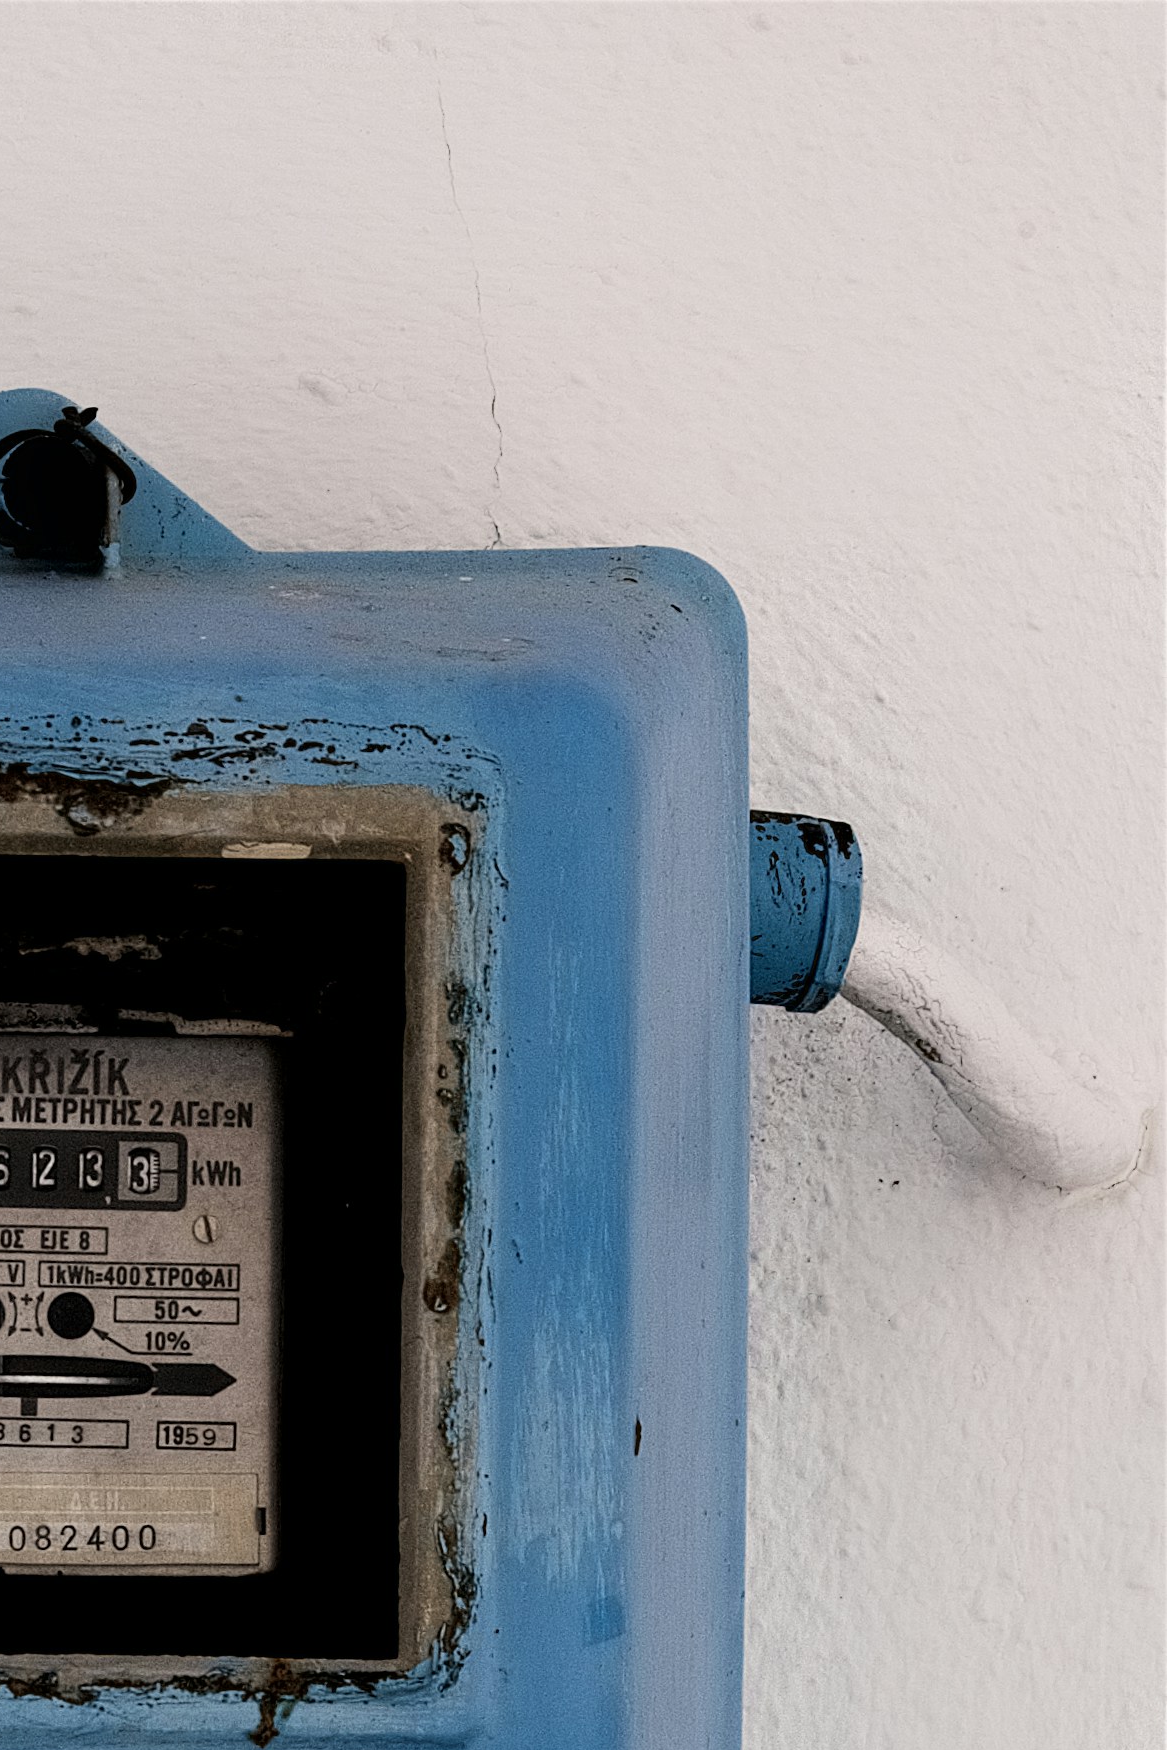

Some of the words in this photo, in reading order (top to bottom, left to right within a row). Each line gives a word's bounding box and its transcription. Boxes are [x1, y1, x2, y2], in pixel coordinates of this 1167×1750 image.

[1, 1048, 131, 1097] KŘIŽÍK
[12, 1097, 142, 1126] ΜΕΤΡΗΤΗΣ
[149, 1100, 164, 1126] 2
[191, 1160, 242, 1187] kWh
[79, 1230, 91, 1251] 8
[7, 1263, 19, 1283] V
[145, 1266, 234, 1289] ΣΤΡΟΦΑΙ
[144, 1330, 191, 1352] 10%
[162, 1427, 217, 1447] 1959
[8, 1523, 159, 1551] 082400
